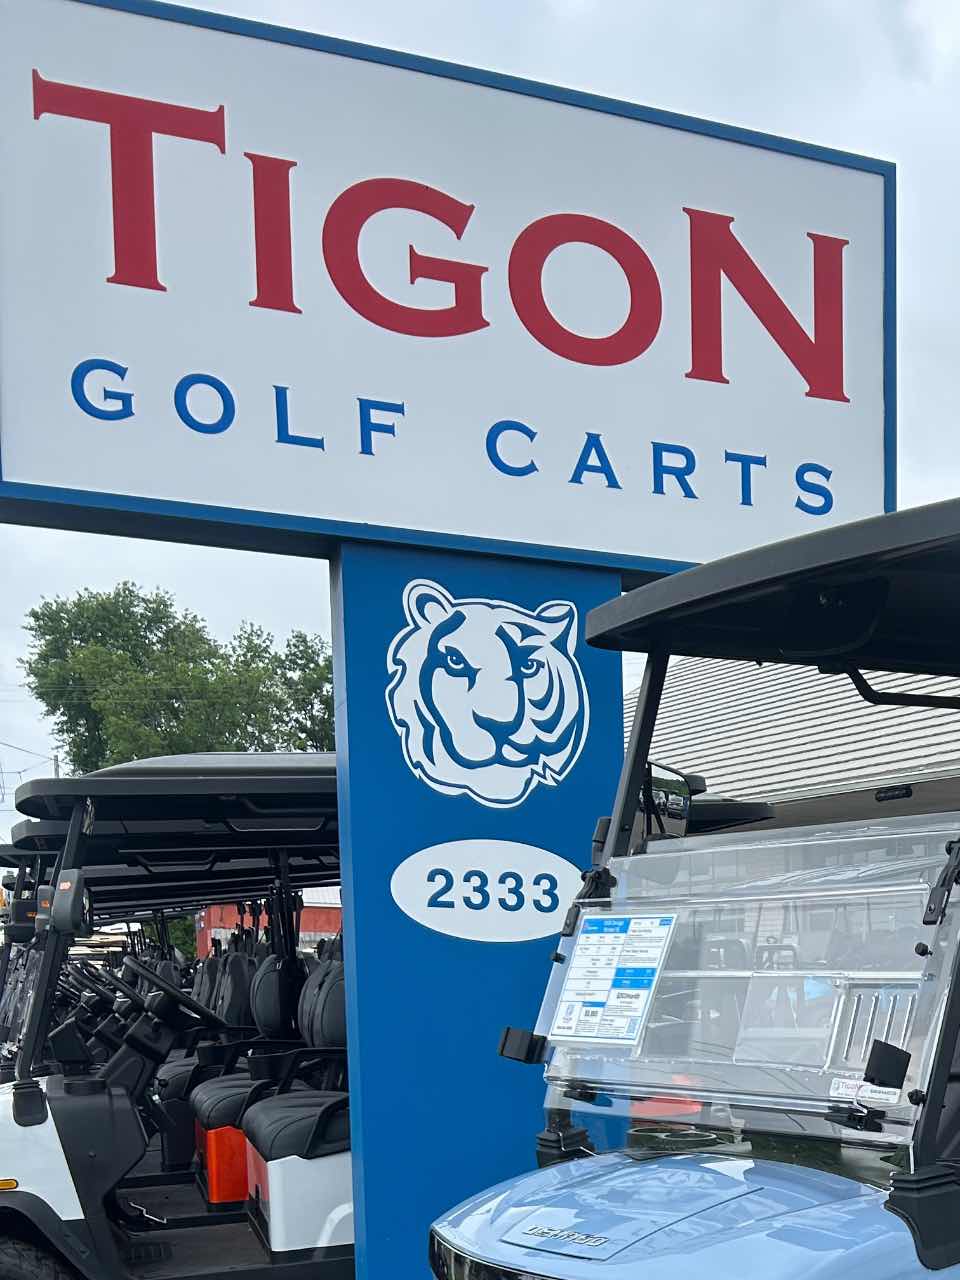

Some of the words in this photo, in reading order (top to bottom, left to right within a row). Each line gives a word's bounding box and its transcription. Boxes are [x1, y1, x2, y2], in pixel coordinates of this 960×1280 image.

[32, 69, 851, 403] TIGON
[69, 357, 408, 458] GOLF
[484, 418, 836, 518] CARTS
[426, 867, 561, 914] 2333
